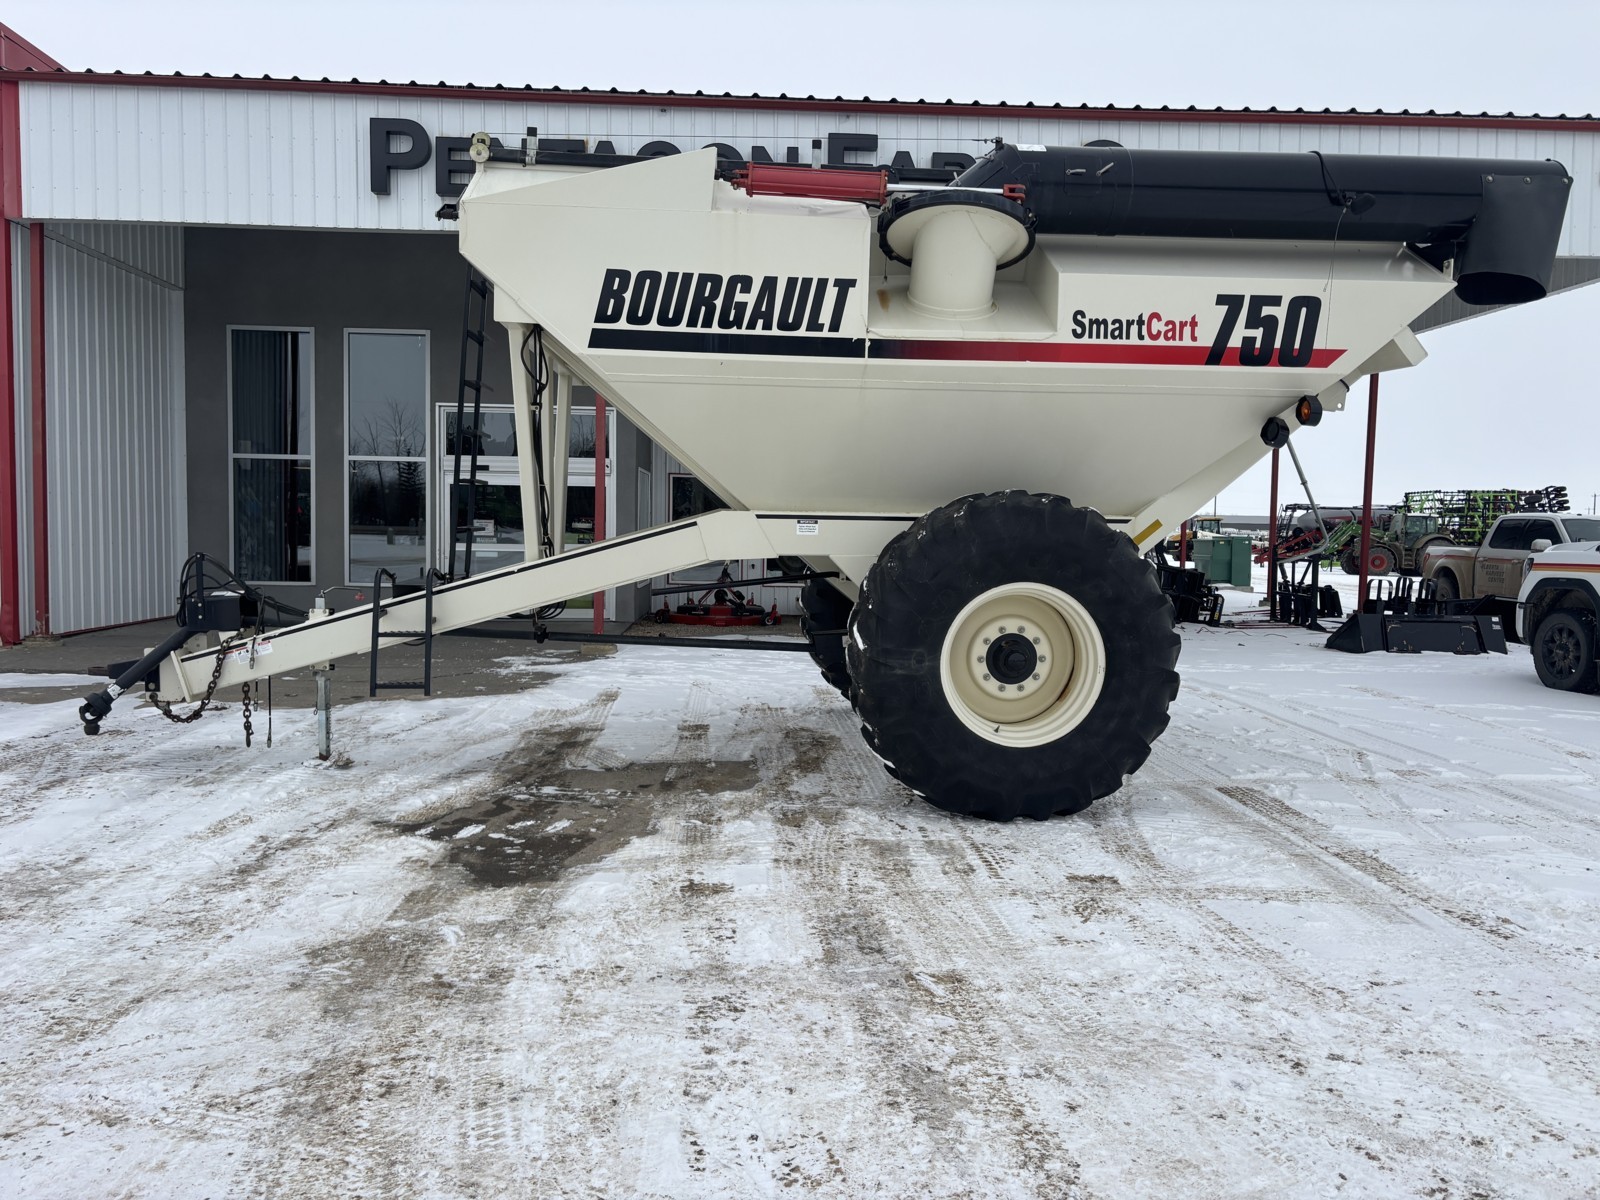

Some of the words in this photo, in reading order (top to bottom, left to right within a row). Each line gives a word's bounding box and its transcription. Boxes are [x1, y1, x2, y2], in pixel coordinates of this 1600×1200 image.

[593, 268, 858, 333] BOURGAULT
[1071, 309, 1198, 342] SmartCart
[1204, 294, 1322, 368] 750
